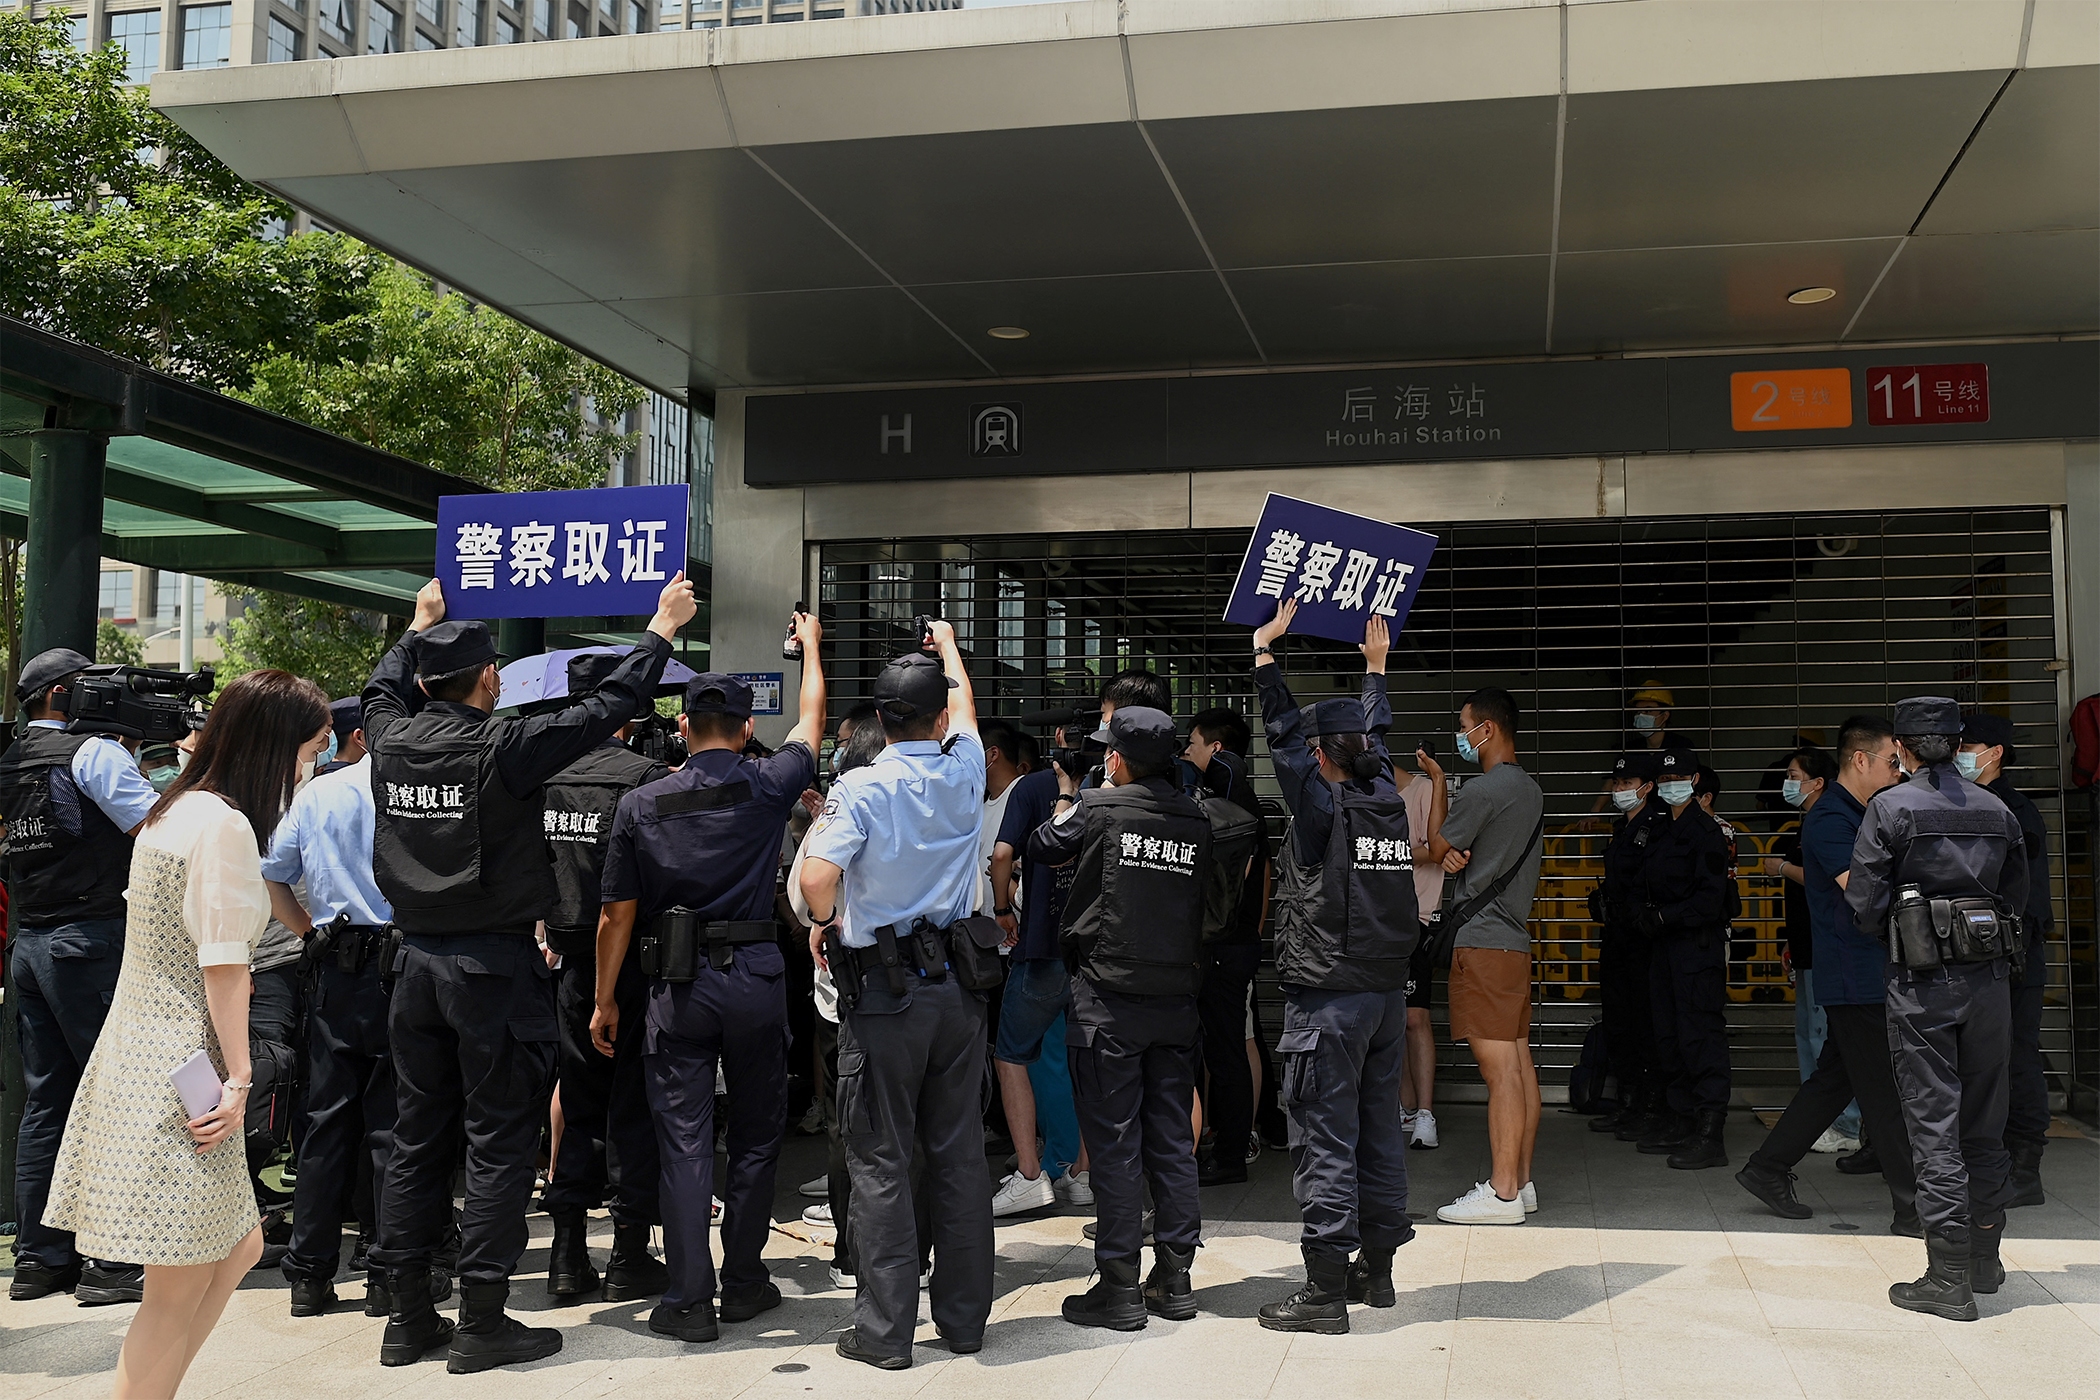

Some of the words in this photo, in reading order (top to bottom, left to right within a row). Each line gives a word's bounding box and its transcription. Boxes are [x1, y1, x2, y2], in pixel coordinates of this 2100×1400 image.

[1341, 382, 1485, 423] 后海站
[1751, 380, 1780, 422] 2
[1788, 387, 1832, 407] 号线
[1874, 373, 1922, 418] 11
[1933, 380, 1981, 402] 号线
[1938, 405, 1964, 414] Line
[1968, 404, 1980, 413] 11
[881, 413, 912, 454] H
[1326, 428, 1408, 447] Houhai
[1416, 425, 1501, 444] Station
[455, 519, 667, 589] 警察取证
[1255, 529, 1415, 617] 警察取证
[386, 782, 464, 809] 警察取证
[426, 811, 464, 819] Collecting
[543, 810, 602, 833] 警察取证
[1120, 832, 1197, 865] 警察取证
[1119, 858, 1140, 867] Police
[1141, 861, 1168, 871] Evidence
[1353, 862, 1375, 870] Police
